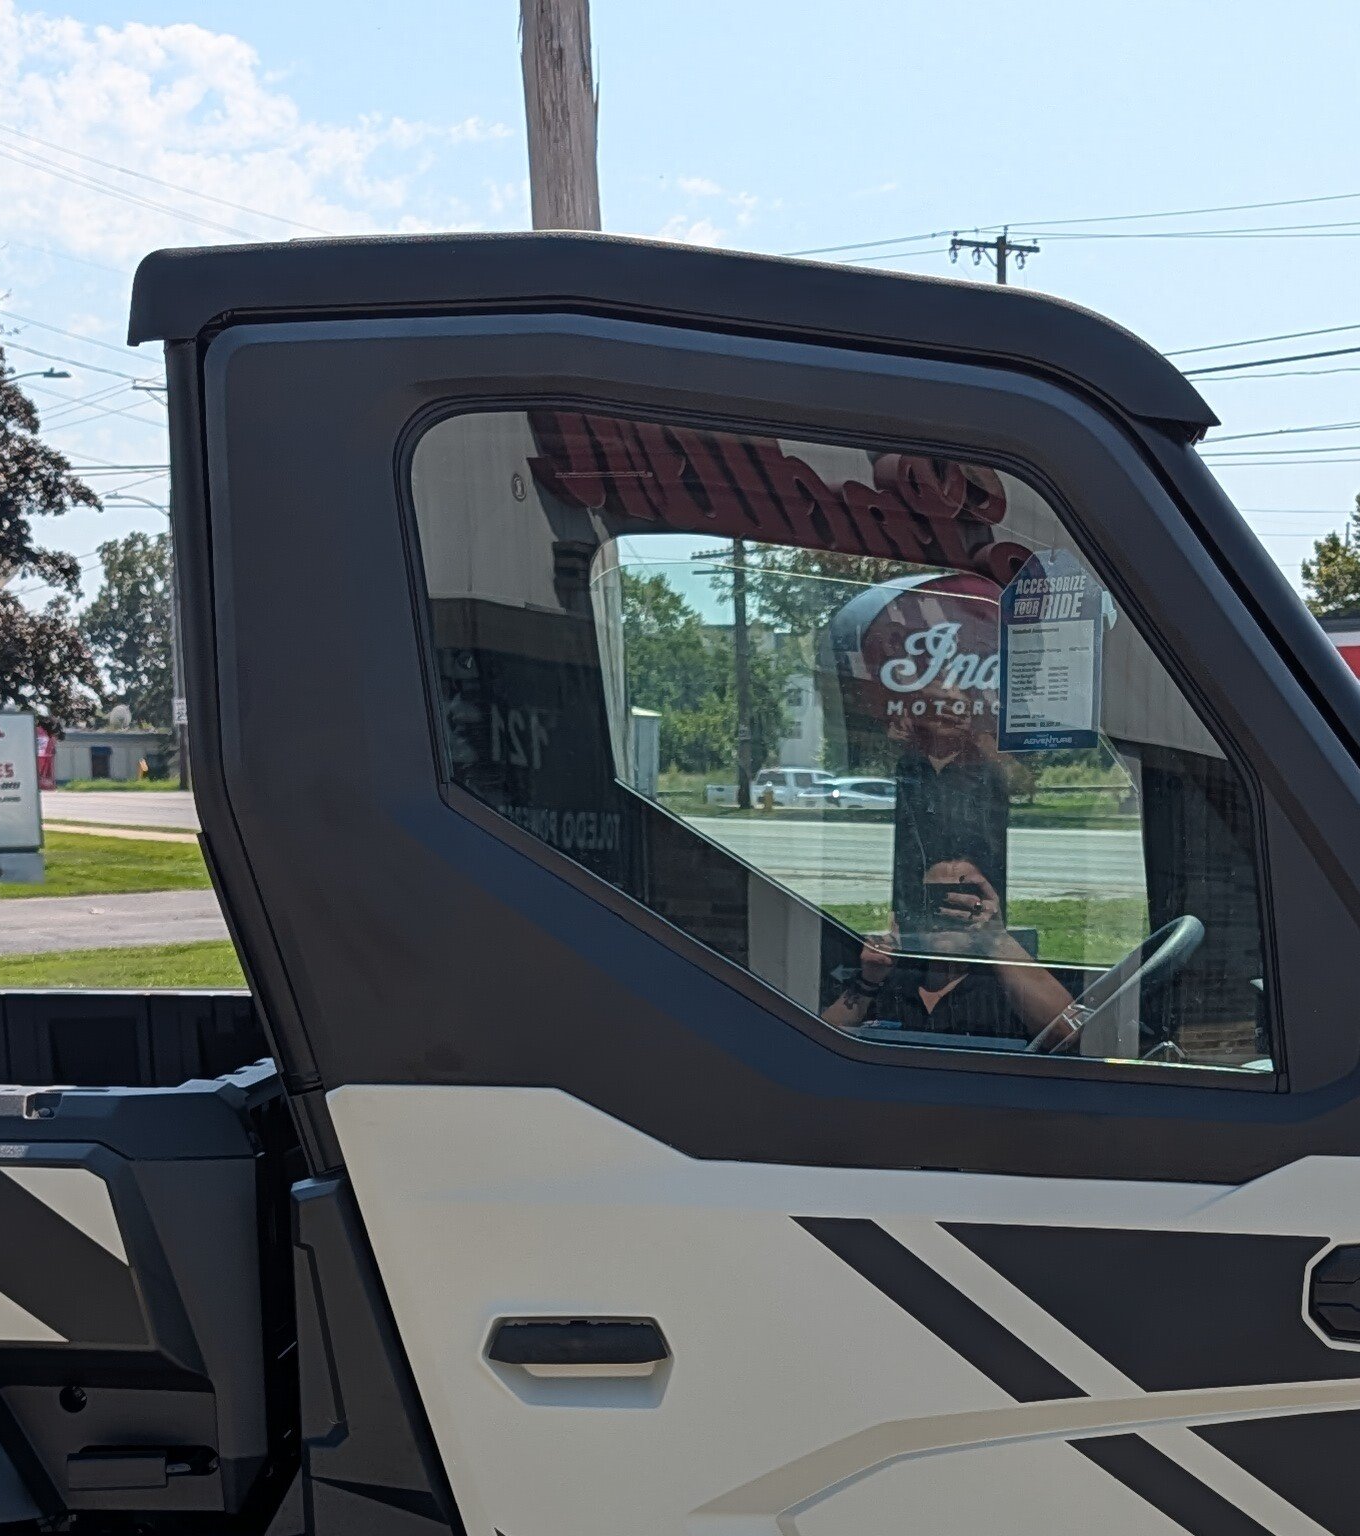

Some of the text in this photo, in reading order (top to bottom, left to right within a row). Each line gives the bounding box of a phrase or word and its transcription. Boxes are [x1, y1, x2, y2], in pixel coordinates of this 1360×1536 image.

[1015, 575, 1087, 595] ACCESSORIZE
[1014, 592, 1084, 620] YOUR RIDE
